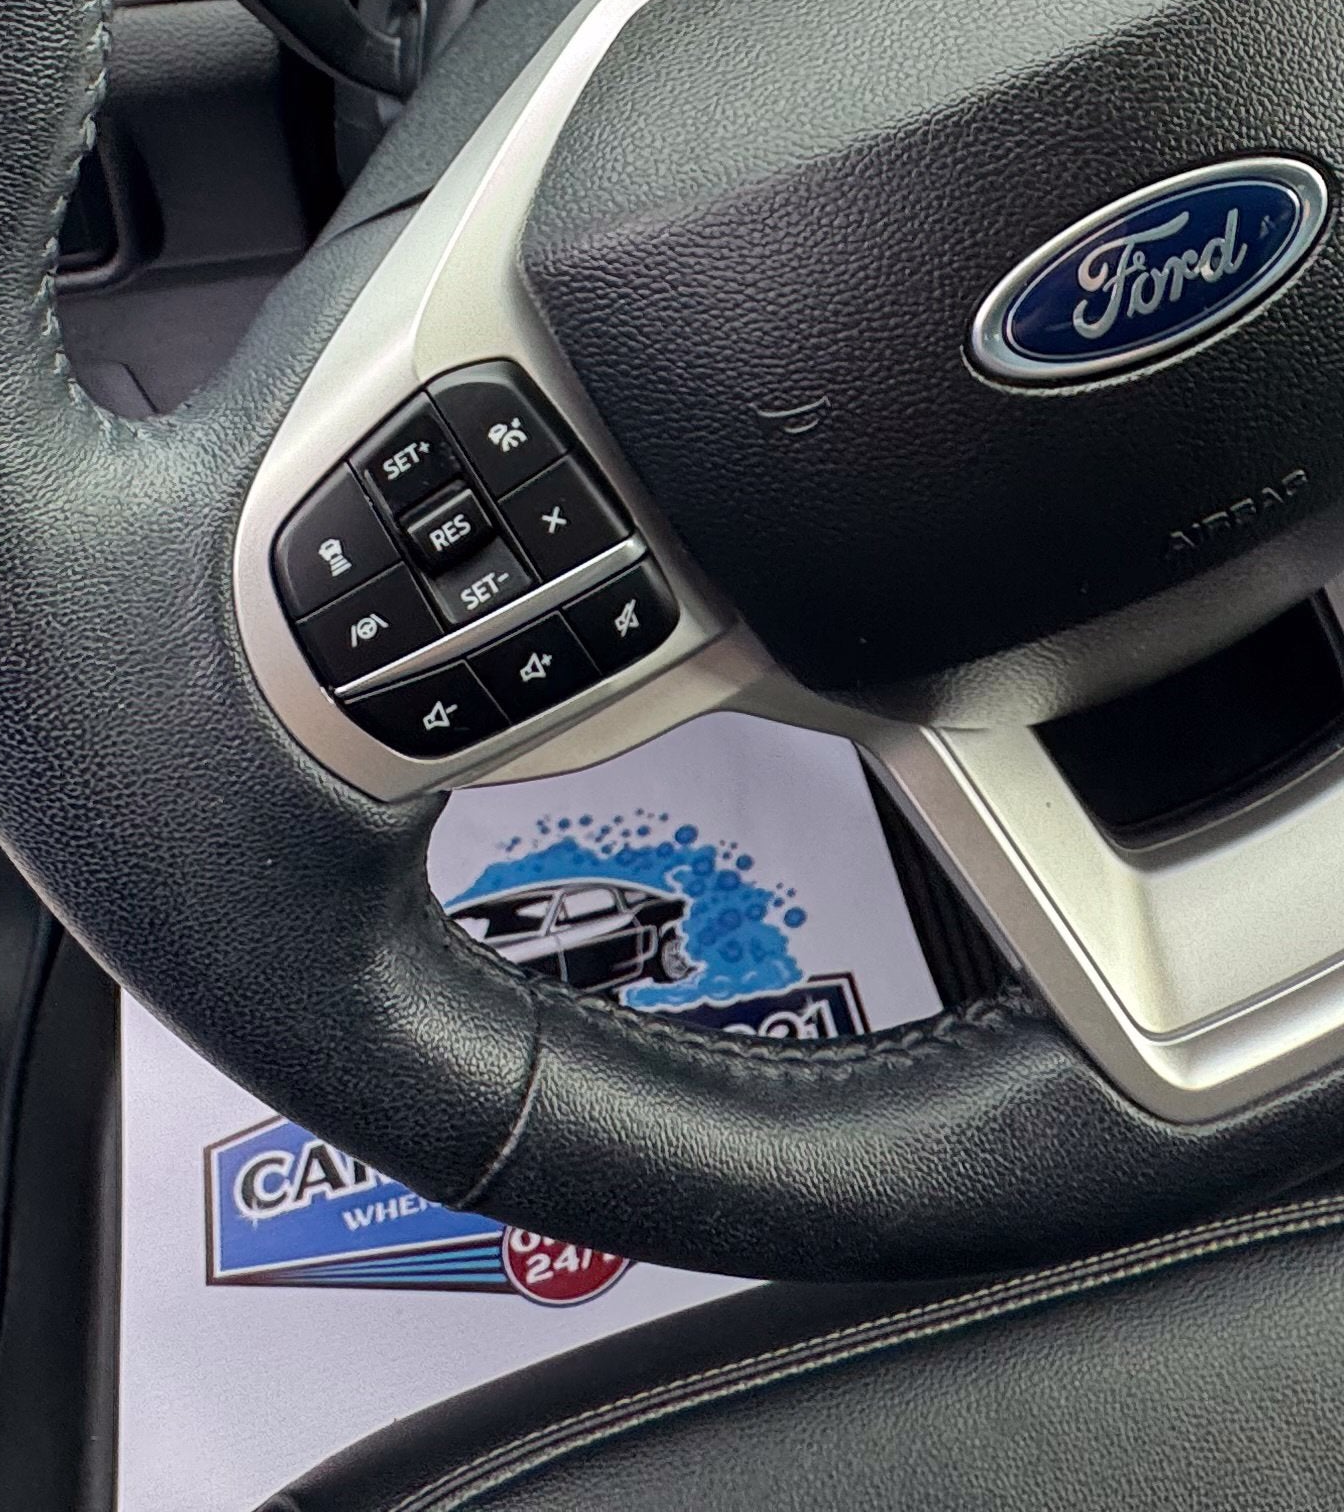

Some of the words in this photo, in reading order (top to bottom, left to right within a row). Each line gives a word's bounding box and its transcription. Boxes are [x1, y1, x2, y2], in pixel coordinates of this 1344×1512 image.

[1073, 208, 1248, 339] Ford
[383, 441, 431, 480] SET+
[430, 514, 472, 552] RES
[461, 570, 509, 610] SET-
[526, 1245, 616, 1284] 24/
